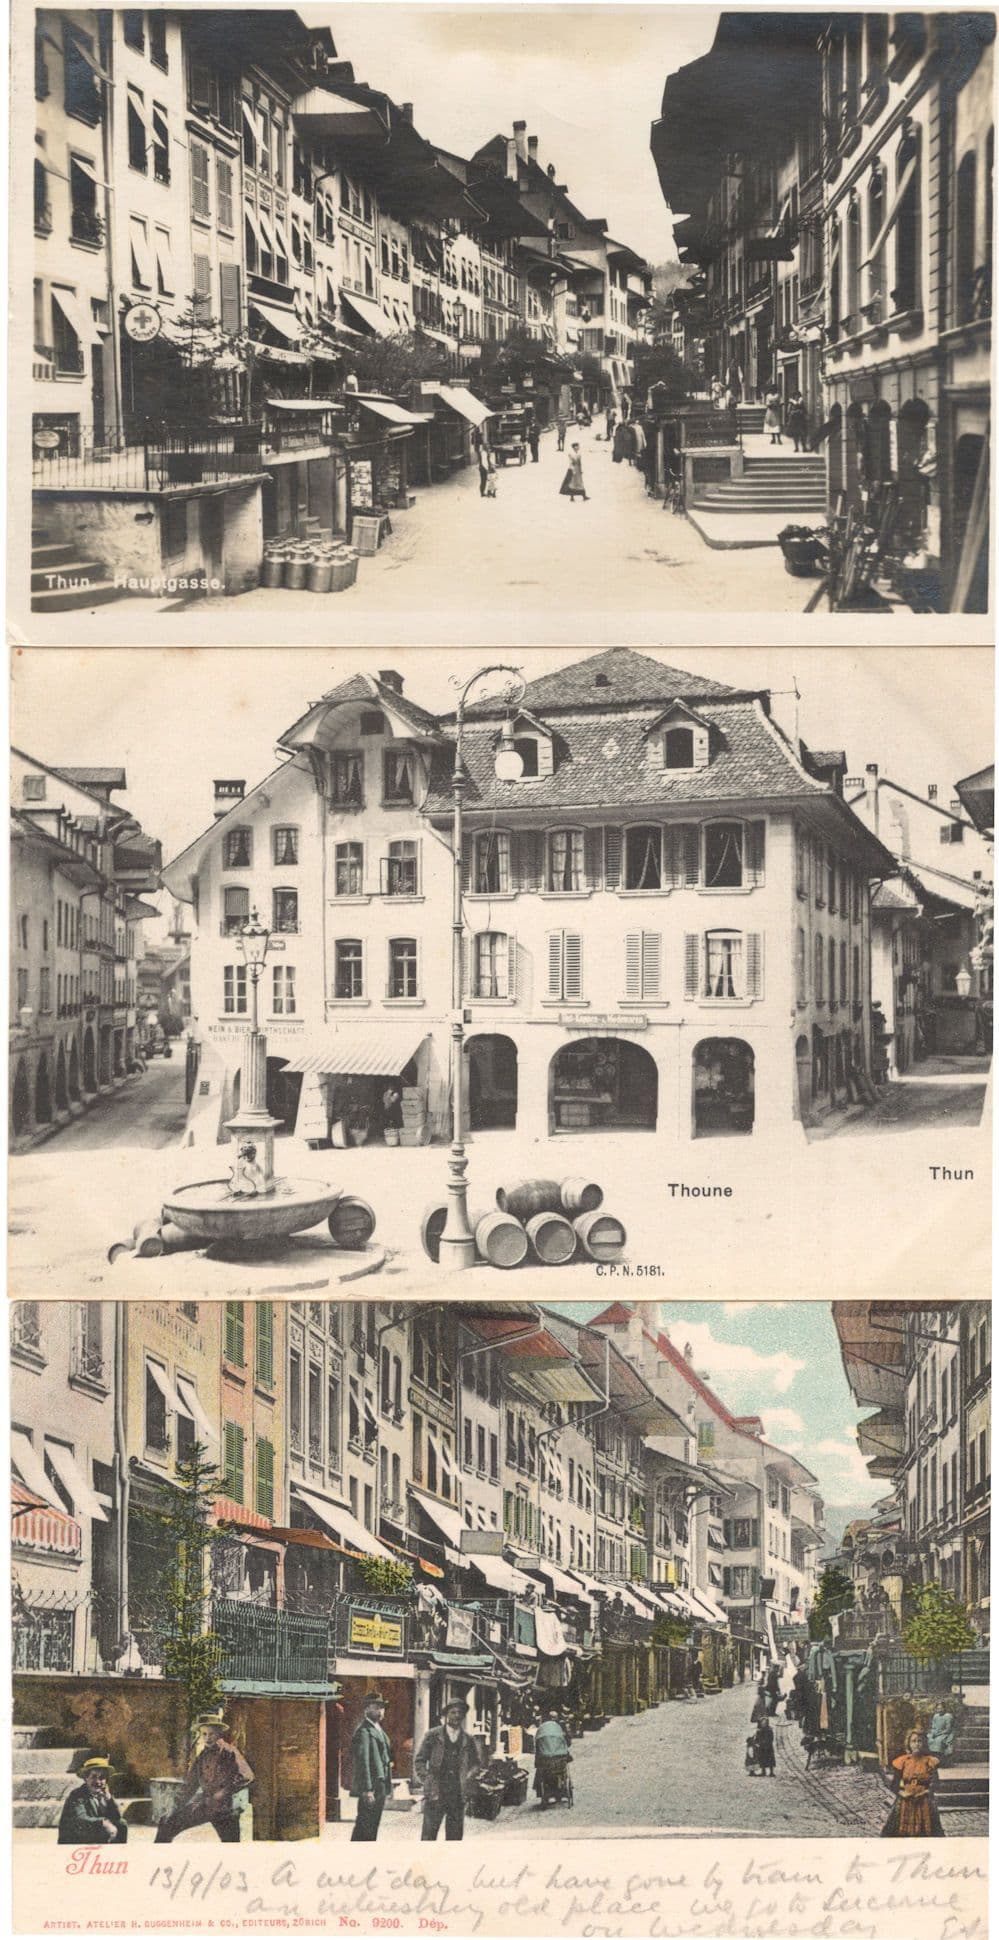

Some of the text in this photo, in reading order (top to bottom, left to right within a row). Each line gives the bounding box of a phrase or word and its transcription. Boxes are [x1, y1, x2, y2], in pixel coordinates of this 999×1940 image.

[271, 1860, 300, 1888] A
[391, 1868, 450, 1913] day
[472, 1864, 534, 1889] but
[545, 1864, 611, 1889] have
[623, 1874, 689, 1901] gone
[704, 1861, 724, 1900] by
[742, 1858, 824, 1885] train
[846, 1853, 879, 1884] to
[887, 1851, 988, 1883] Thun
[246, 1897, 301, 1917] an
[498, 1894, 552, 1917] old
[561, 1891, 662, 1926] place
[582, 1924, 624, 1938] on
